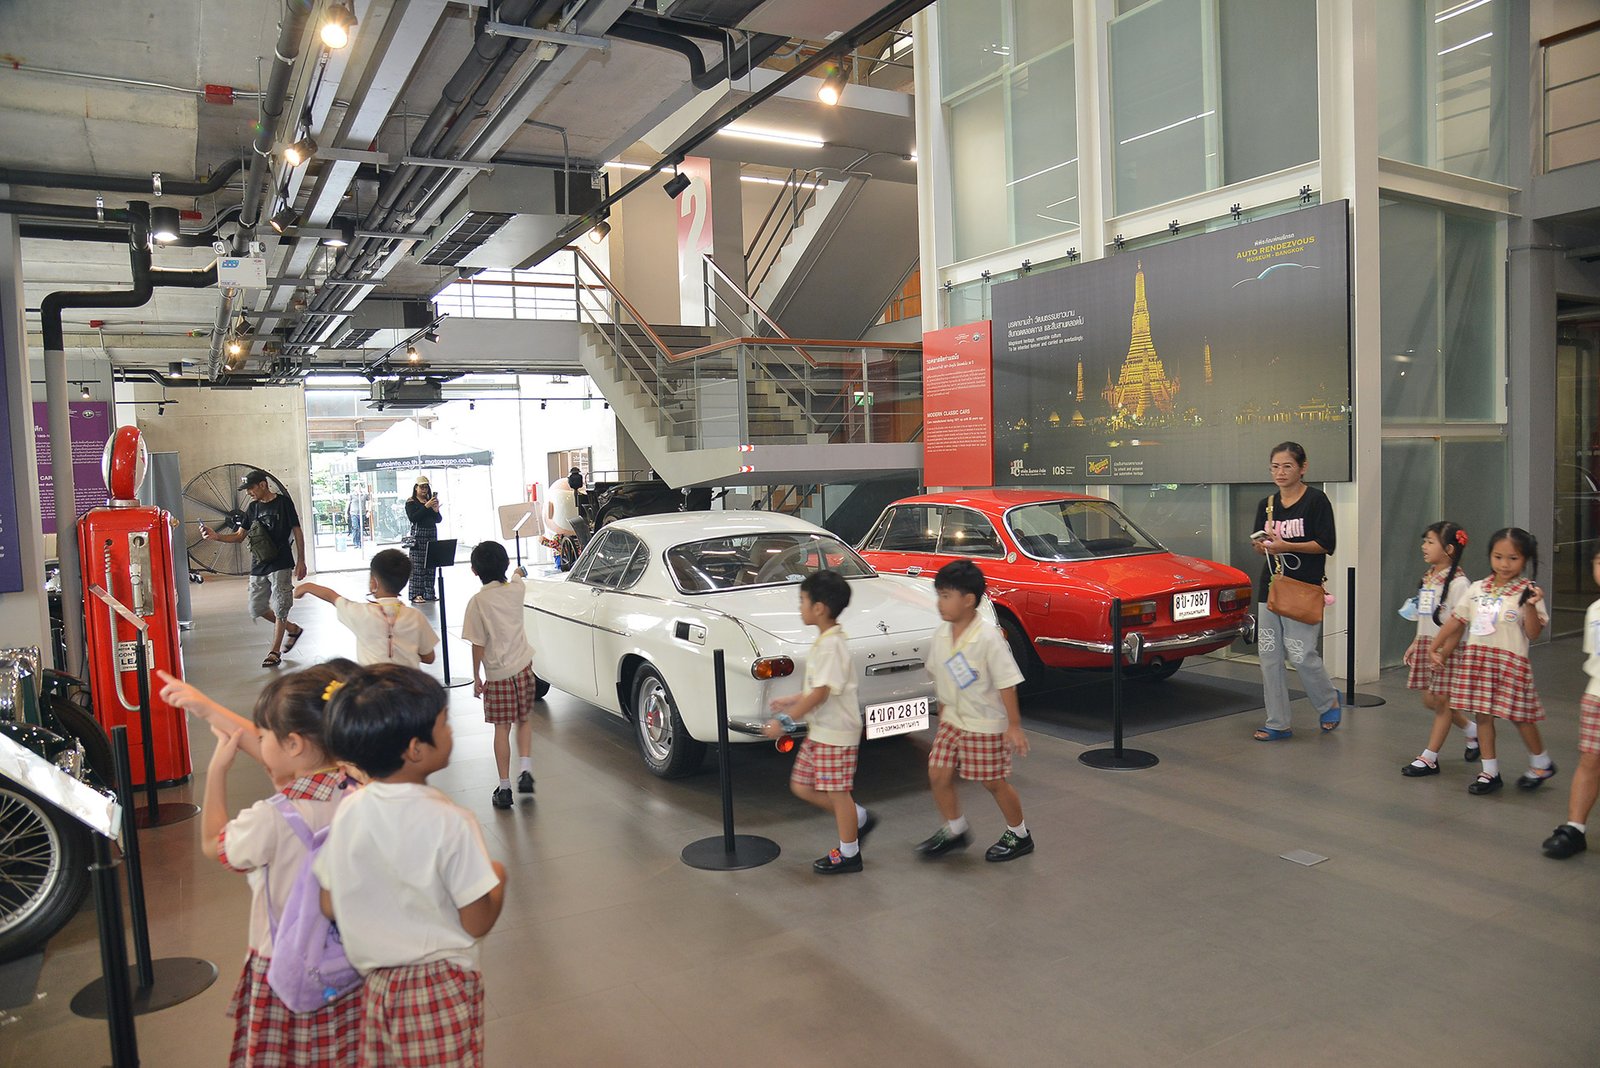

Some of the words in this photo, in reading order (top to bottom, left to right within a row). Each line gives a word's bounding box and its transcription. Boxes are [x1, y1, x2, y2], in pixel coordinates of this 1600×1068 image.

[681, 175, 711, 284] 2
[1236, 249, 1258, 259] AUTO
[1259, 236, 1315, 254] RENDEZVOUS
[1246, 253, 1271, 263] MUSEUM
[1274, 246, 1304, 257] BANGKOK
